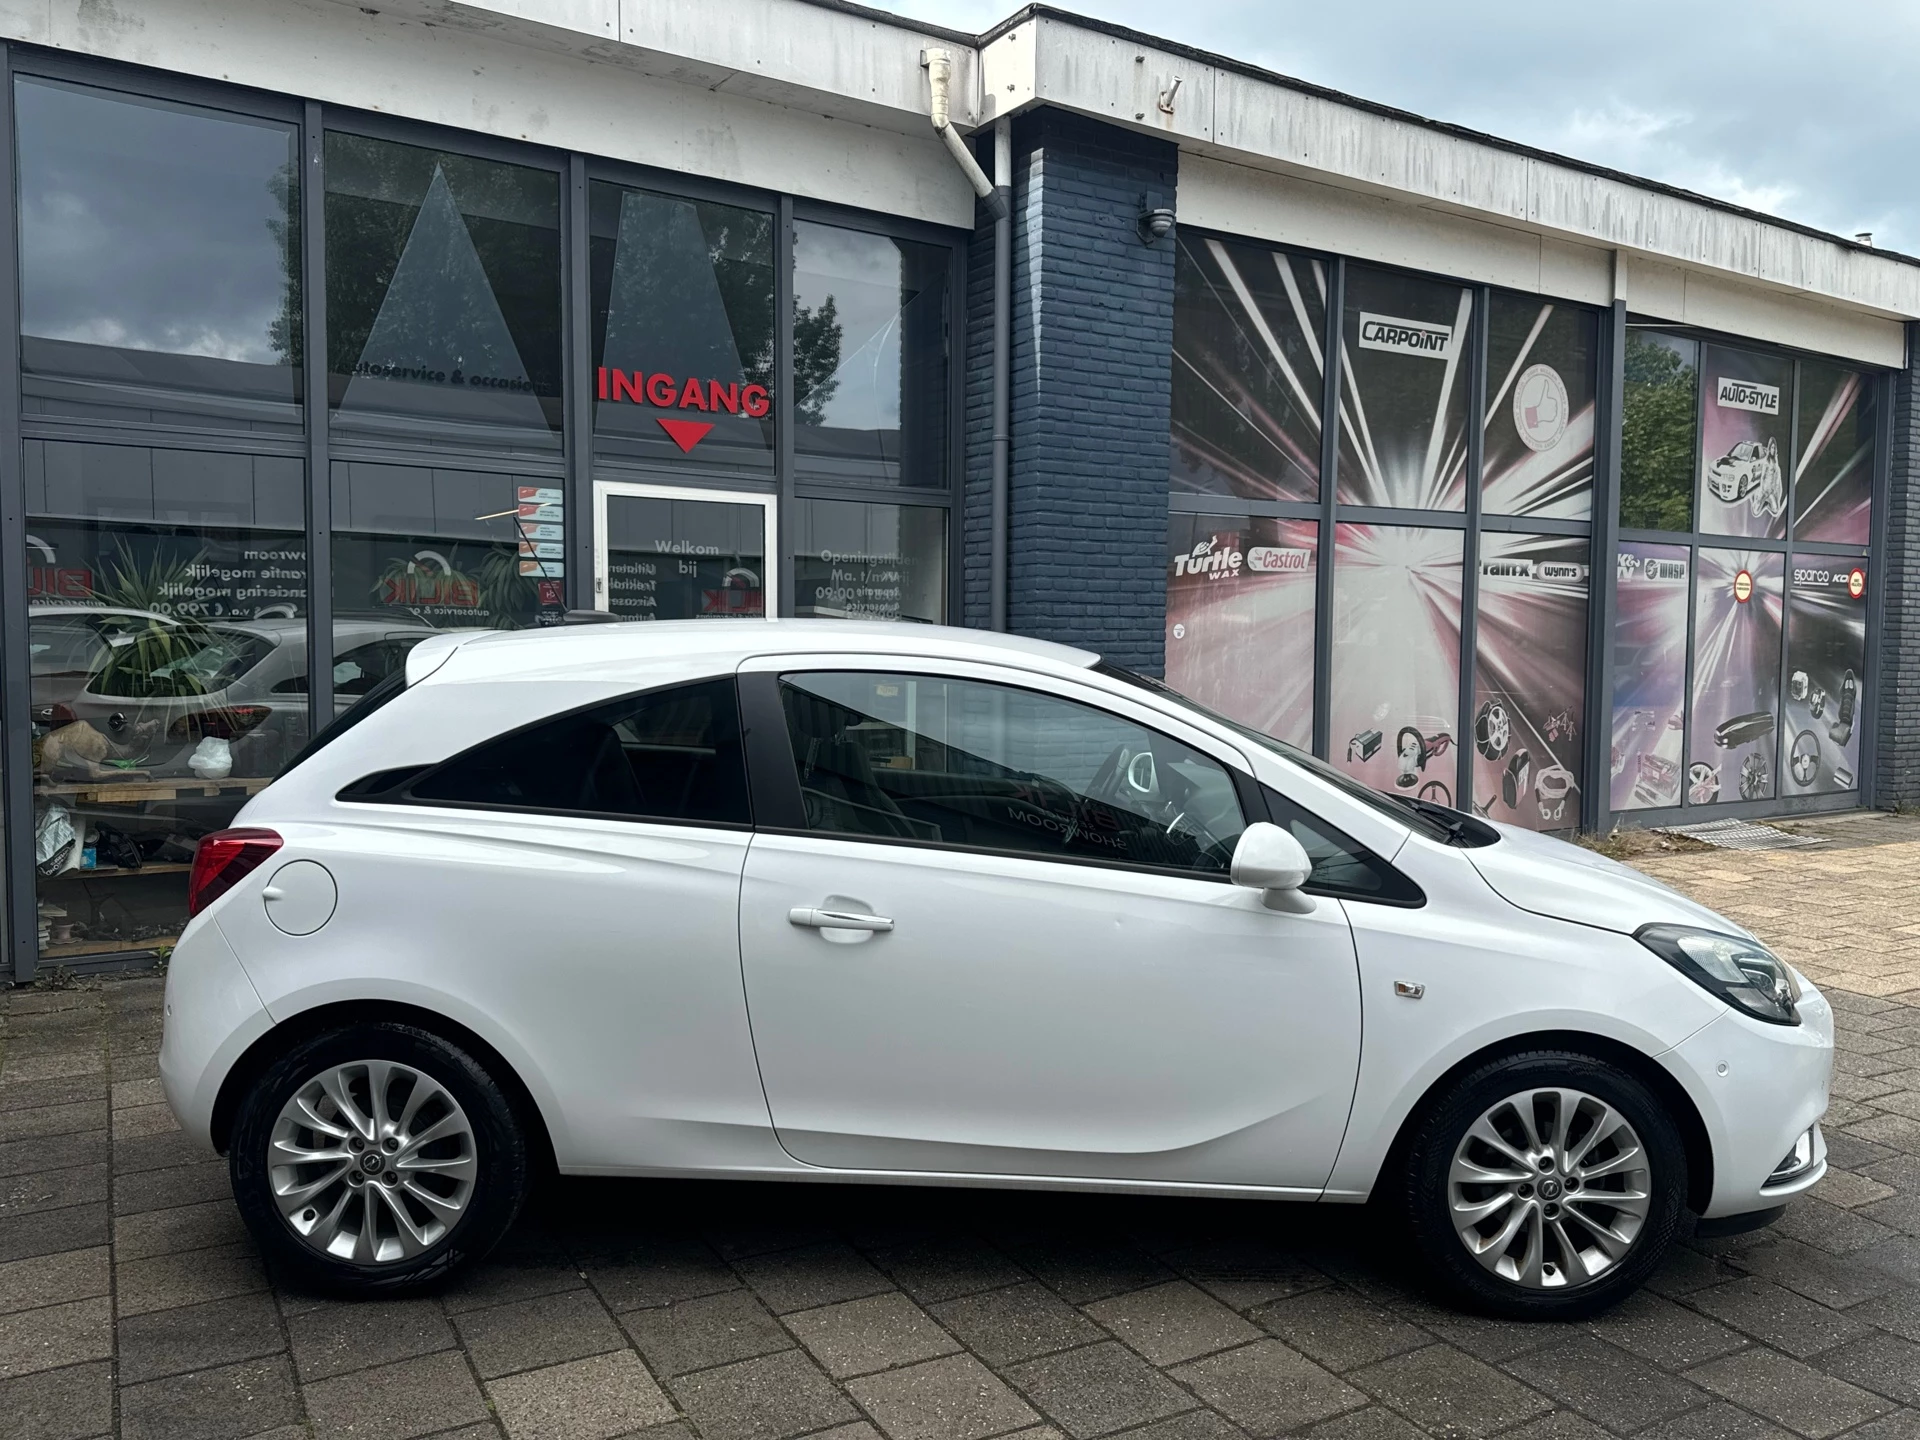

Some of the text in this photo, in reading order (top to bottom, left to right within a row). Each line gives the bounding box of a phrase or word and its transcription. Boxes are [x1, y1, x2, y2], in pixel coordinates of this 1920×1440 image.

[450, 368, 466, 385] &
[597, 366, 771, 417] INGANG
[654, 539, 720, 555] Welkom
[1174, 546, 1243, 577] Turtle
[1262, 550, 1307, 569] Castrol
[678, 559, 698, 578] bij
[831, 568, 857, 582] Ma.
[1208, 568, 1240, 580] WAX
[1659, 562, 1685, 580] WASP
[1793, 568, 1830, 585] sparco
[1832, 573, 1849, 583] KO
[815, 586, 855, 600] 09:00
